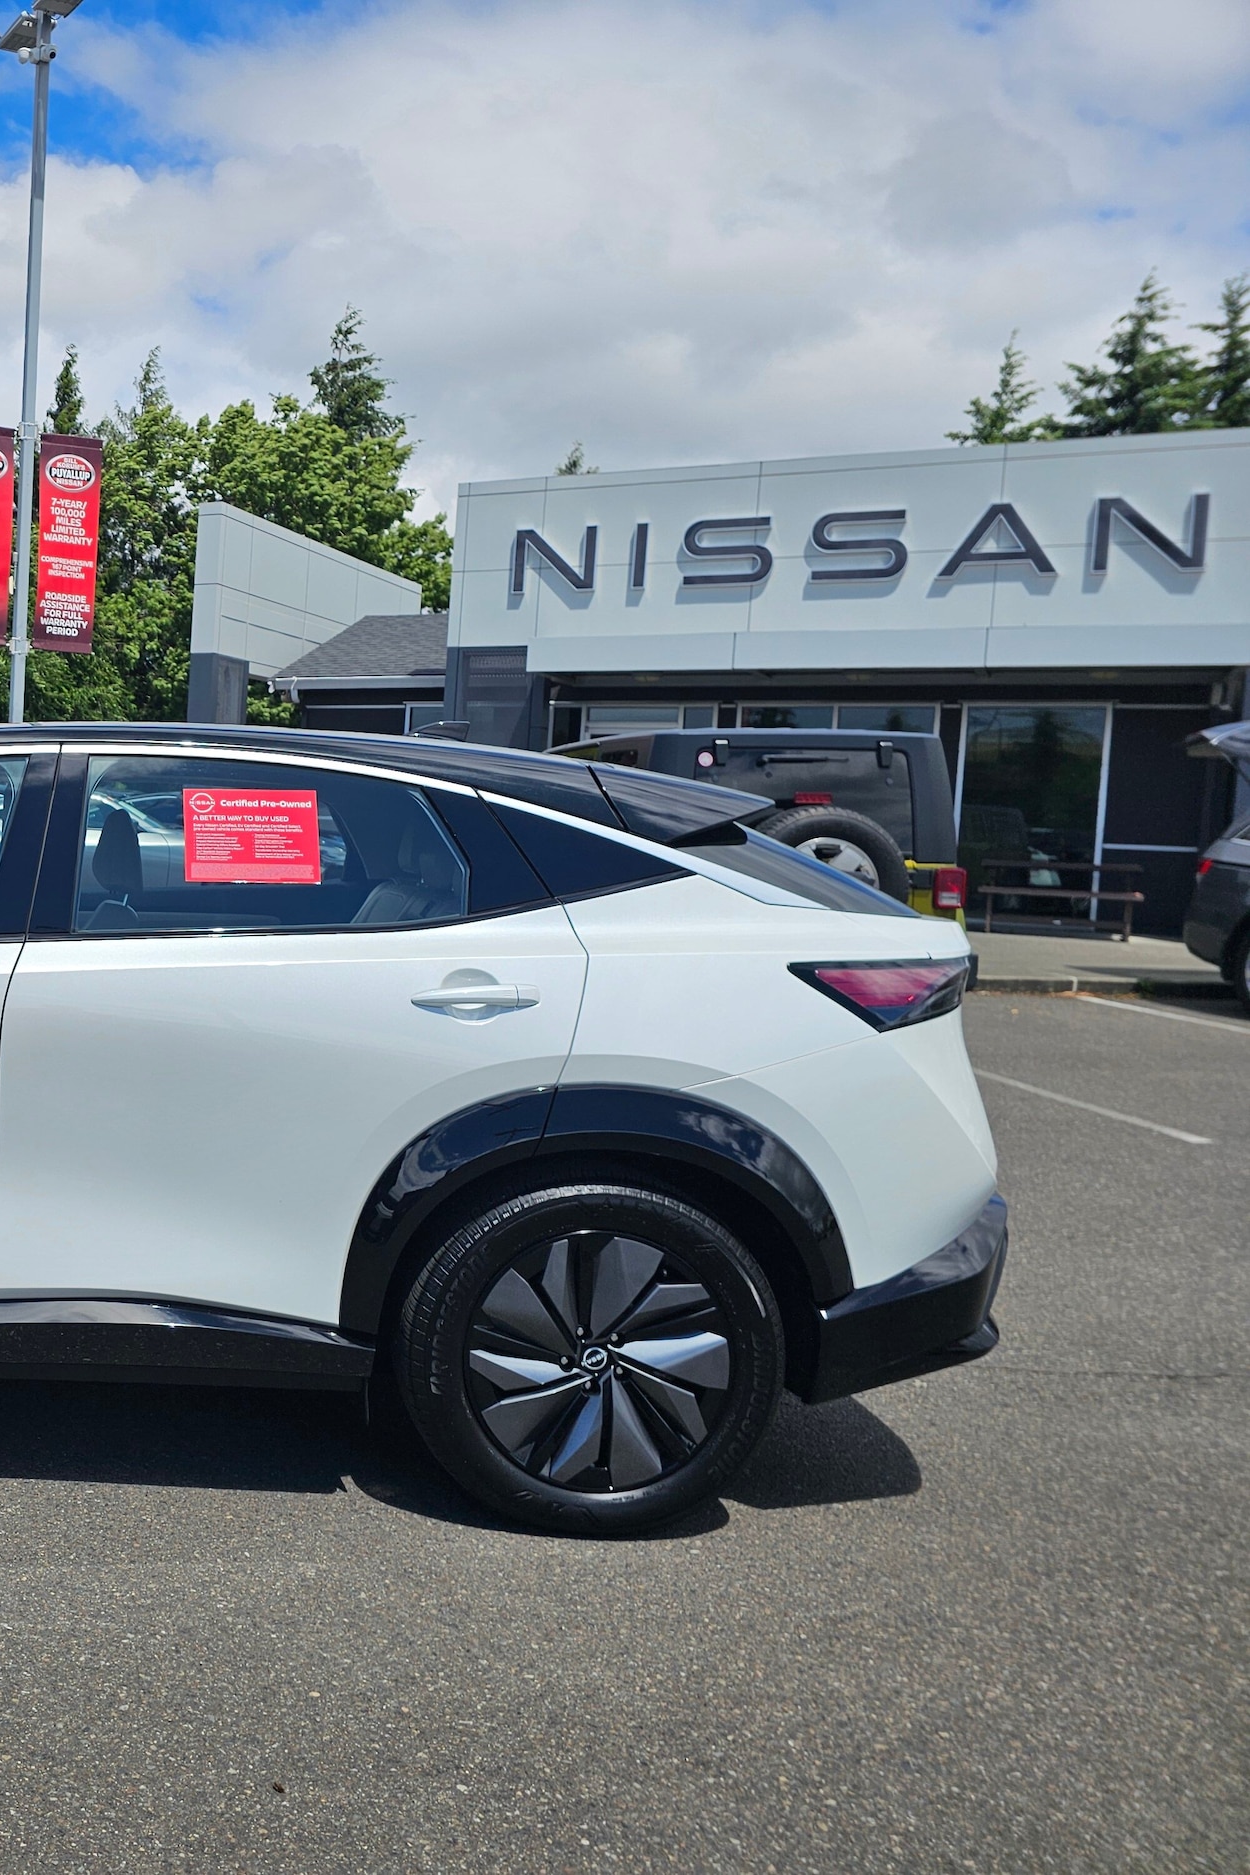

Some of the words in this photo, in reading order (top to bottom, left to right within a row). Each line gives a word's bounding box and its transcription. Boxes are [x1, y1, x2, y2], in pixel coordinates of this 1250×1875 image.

[51, 468, 90, 481] PUYALLUP
[56, 478, 84, 487] NISSAN
[51, 497, 88, 510] 7-YEAR/
[50, 506, 86, 518] 100,000
[56, 516, 82, 527] MILES
[51, 524, 86, 536] LIMITED
[43, 532, 93, 546] WARRANTY
[511, 493, 1211, 595] NISSAN
[41, 556, 94, 568] COMPREHENSIVE
[48, 569, 85, 579] INSPECTION
[45, 591, 86, 603] ROADSIDE
[40, 600, 90, 612] ASSISTANCE
[44, 609, 61, 618] FOR
[62, 611, 83, 620] FULL
[40, 617, 88, 629] WARRANTY
[46, 626, 78, 636] PERIOD
[220, 799, 259, 807] Certified
[260, 800, 312, 808] Pre-Owned
